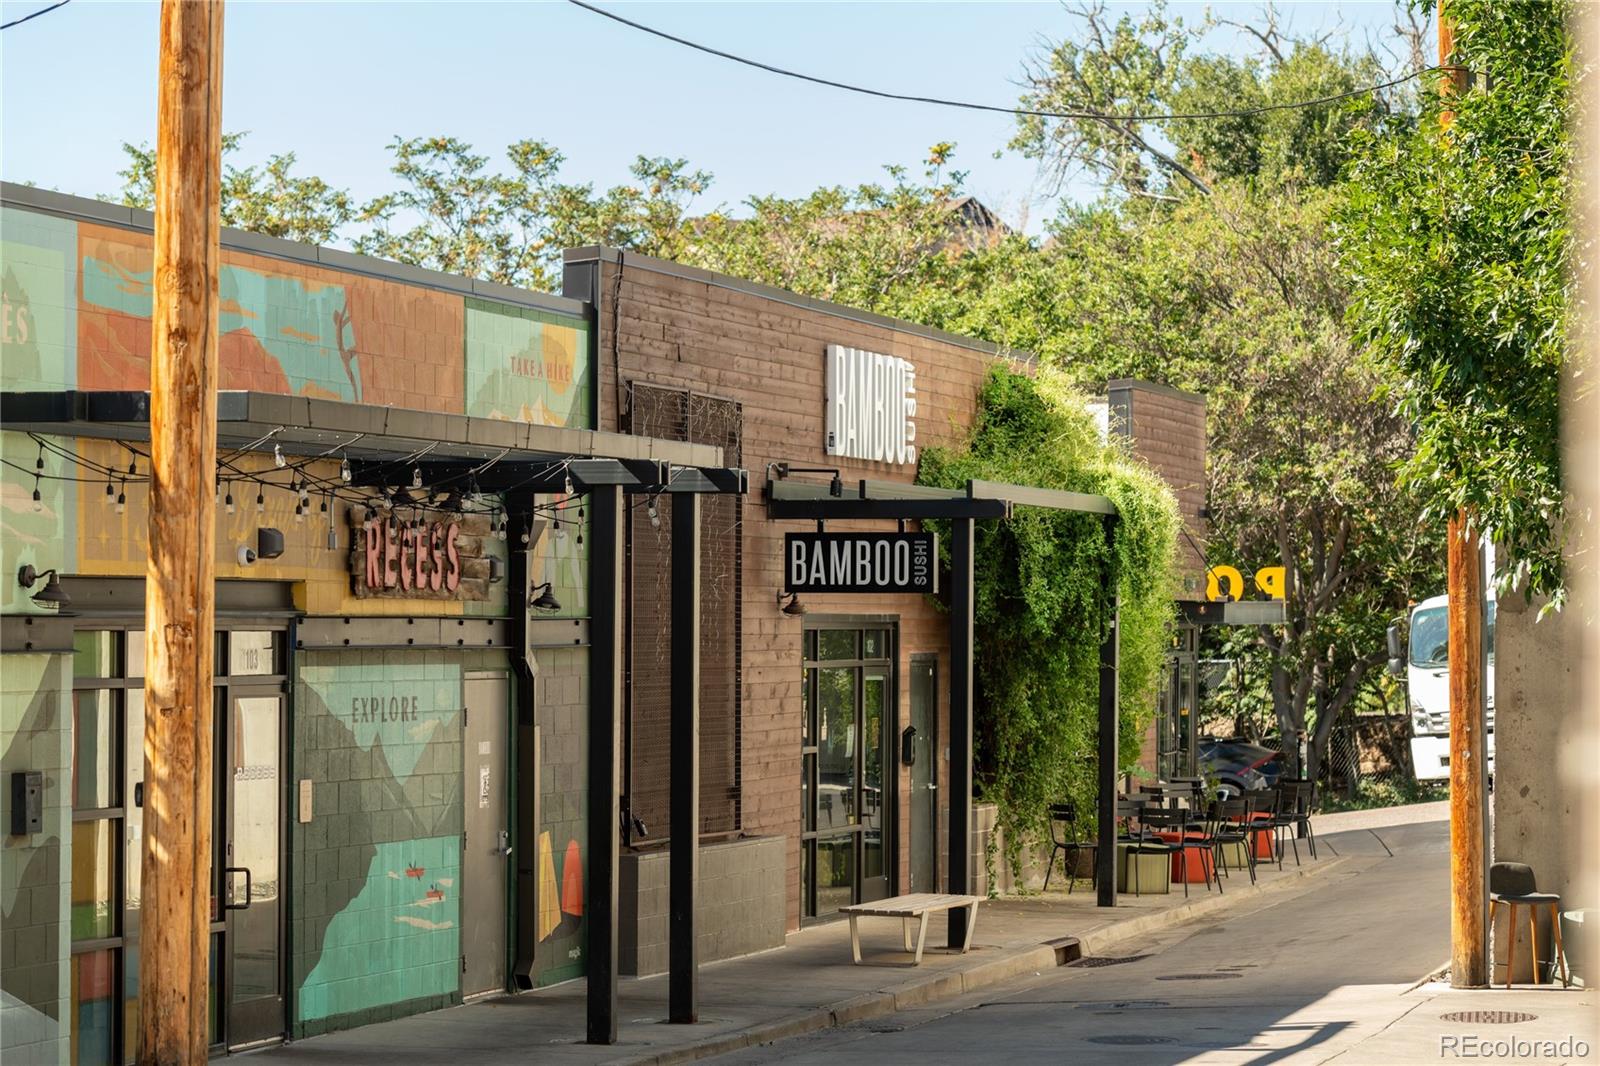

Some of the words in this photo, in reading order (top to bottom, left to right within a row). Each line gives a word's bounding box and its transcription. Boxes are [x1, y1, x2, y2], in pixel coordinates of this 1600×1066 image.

[509, 355, 536, 377] TAKE
[546, 360, 570, 382] HIKE
[830, 344, 907, 466] BAMBOO
[904, 360, 916, 465] SUSHI
[365, 516, 460, 592] RECESS
[791, 539, 910, 586] BAMBOO
[914, 540, 927, 586] SUSHI
[245, 648, 259, 670] 103
[352, 695, 418, 723] EXPLORE
